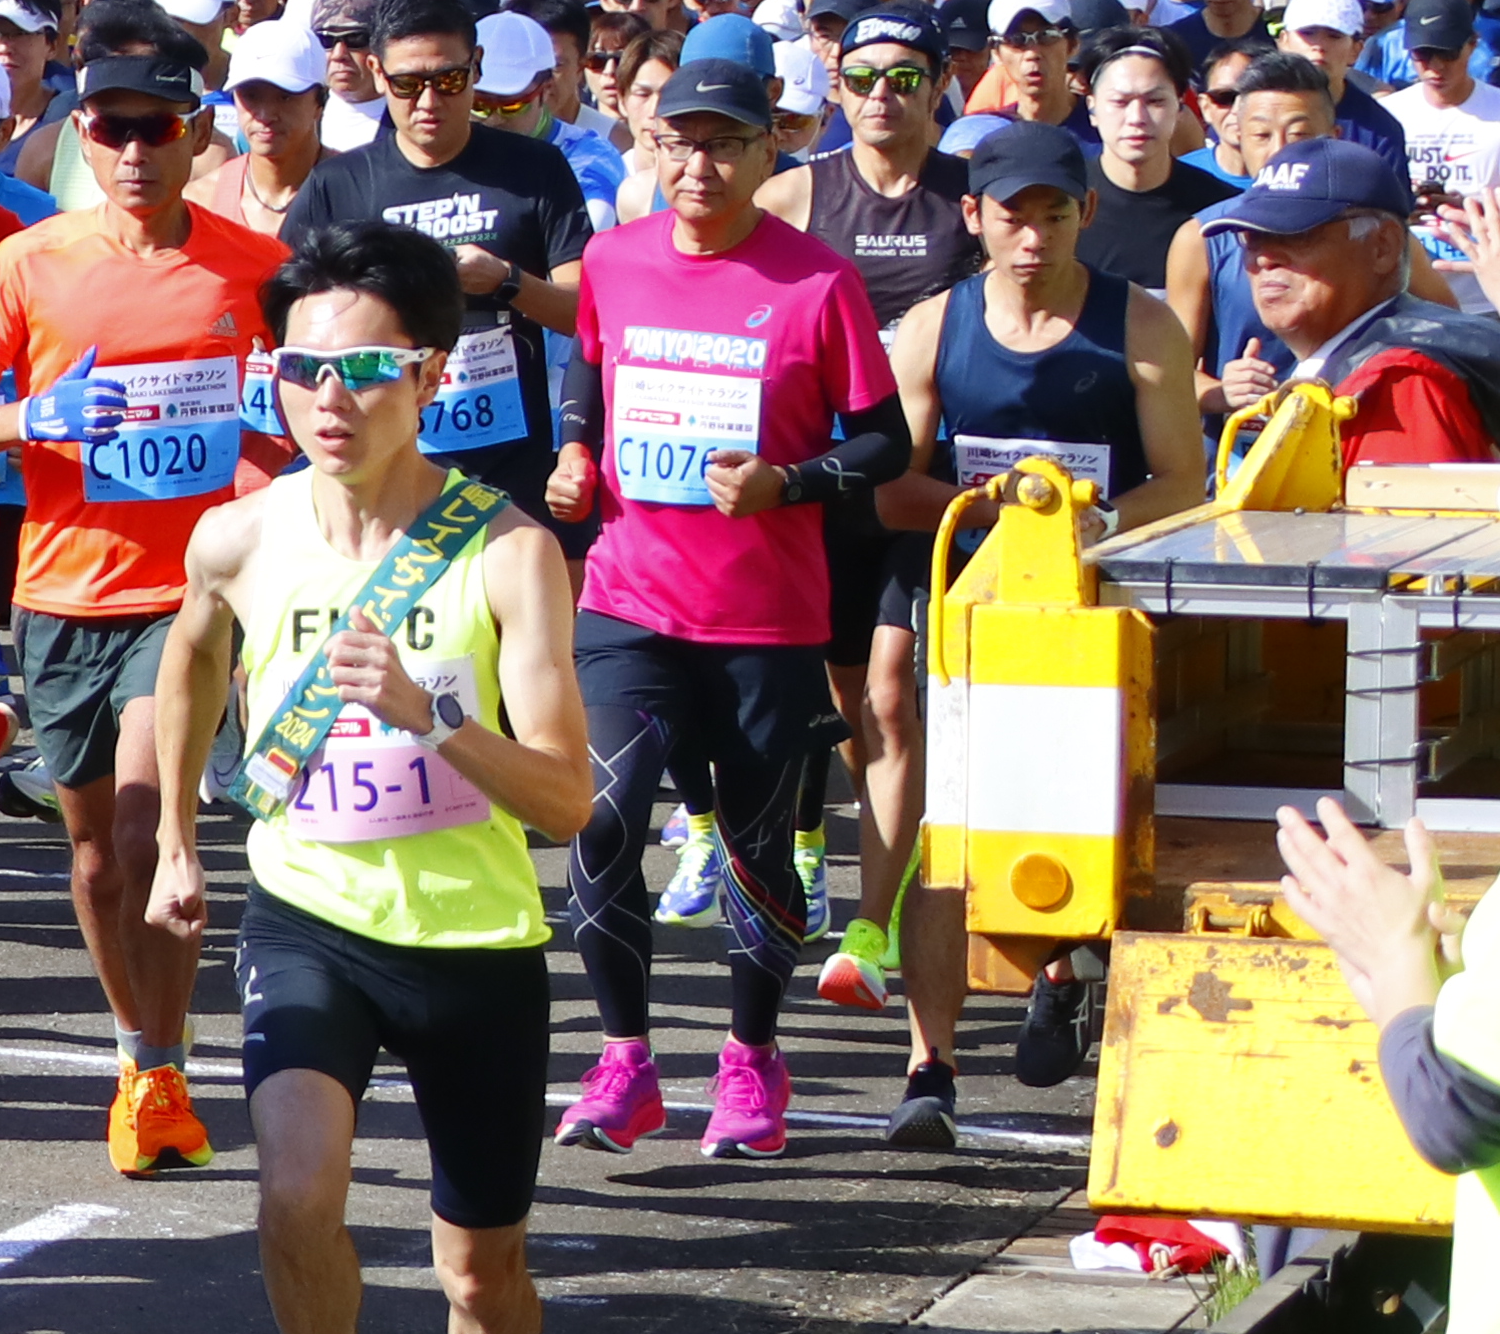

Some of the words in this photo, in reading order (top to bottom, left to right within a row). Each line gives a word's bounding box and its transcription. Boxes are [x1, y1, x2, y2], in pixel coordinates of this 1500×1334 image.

[1252, 163, 1309, 187] JAAF
[1426, 165, 1450, 181] DO
[855, 235, 927, 248] SAURUS
[899, 248, 927, 257] CLUB
[417, 394, 495, 434] 768
[89, 433, 207, 481] C1020
[274, 712, 318, 750] 2024
